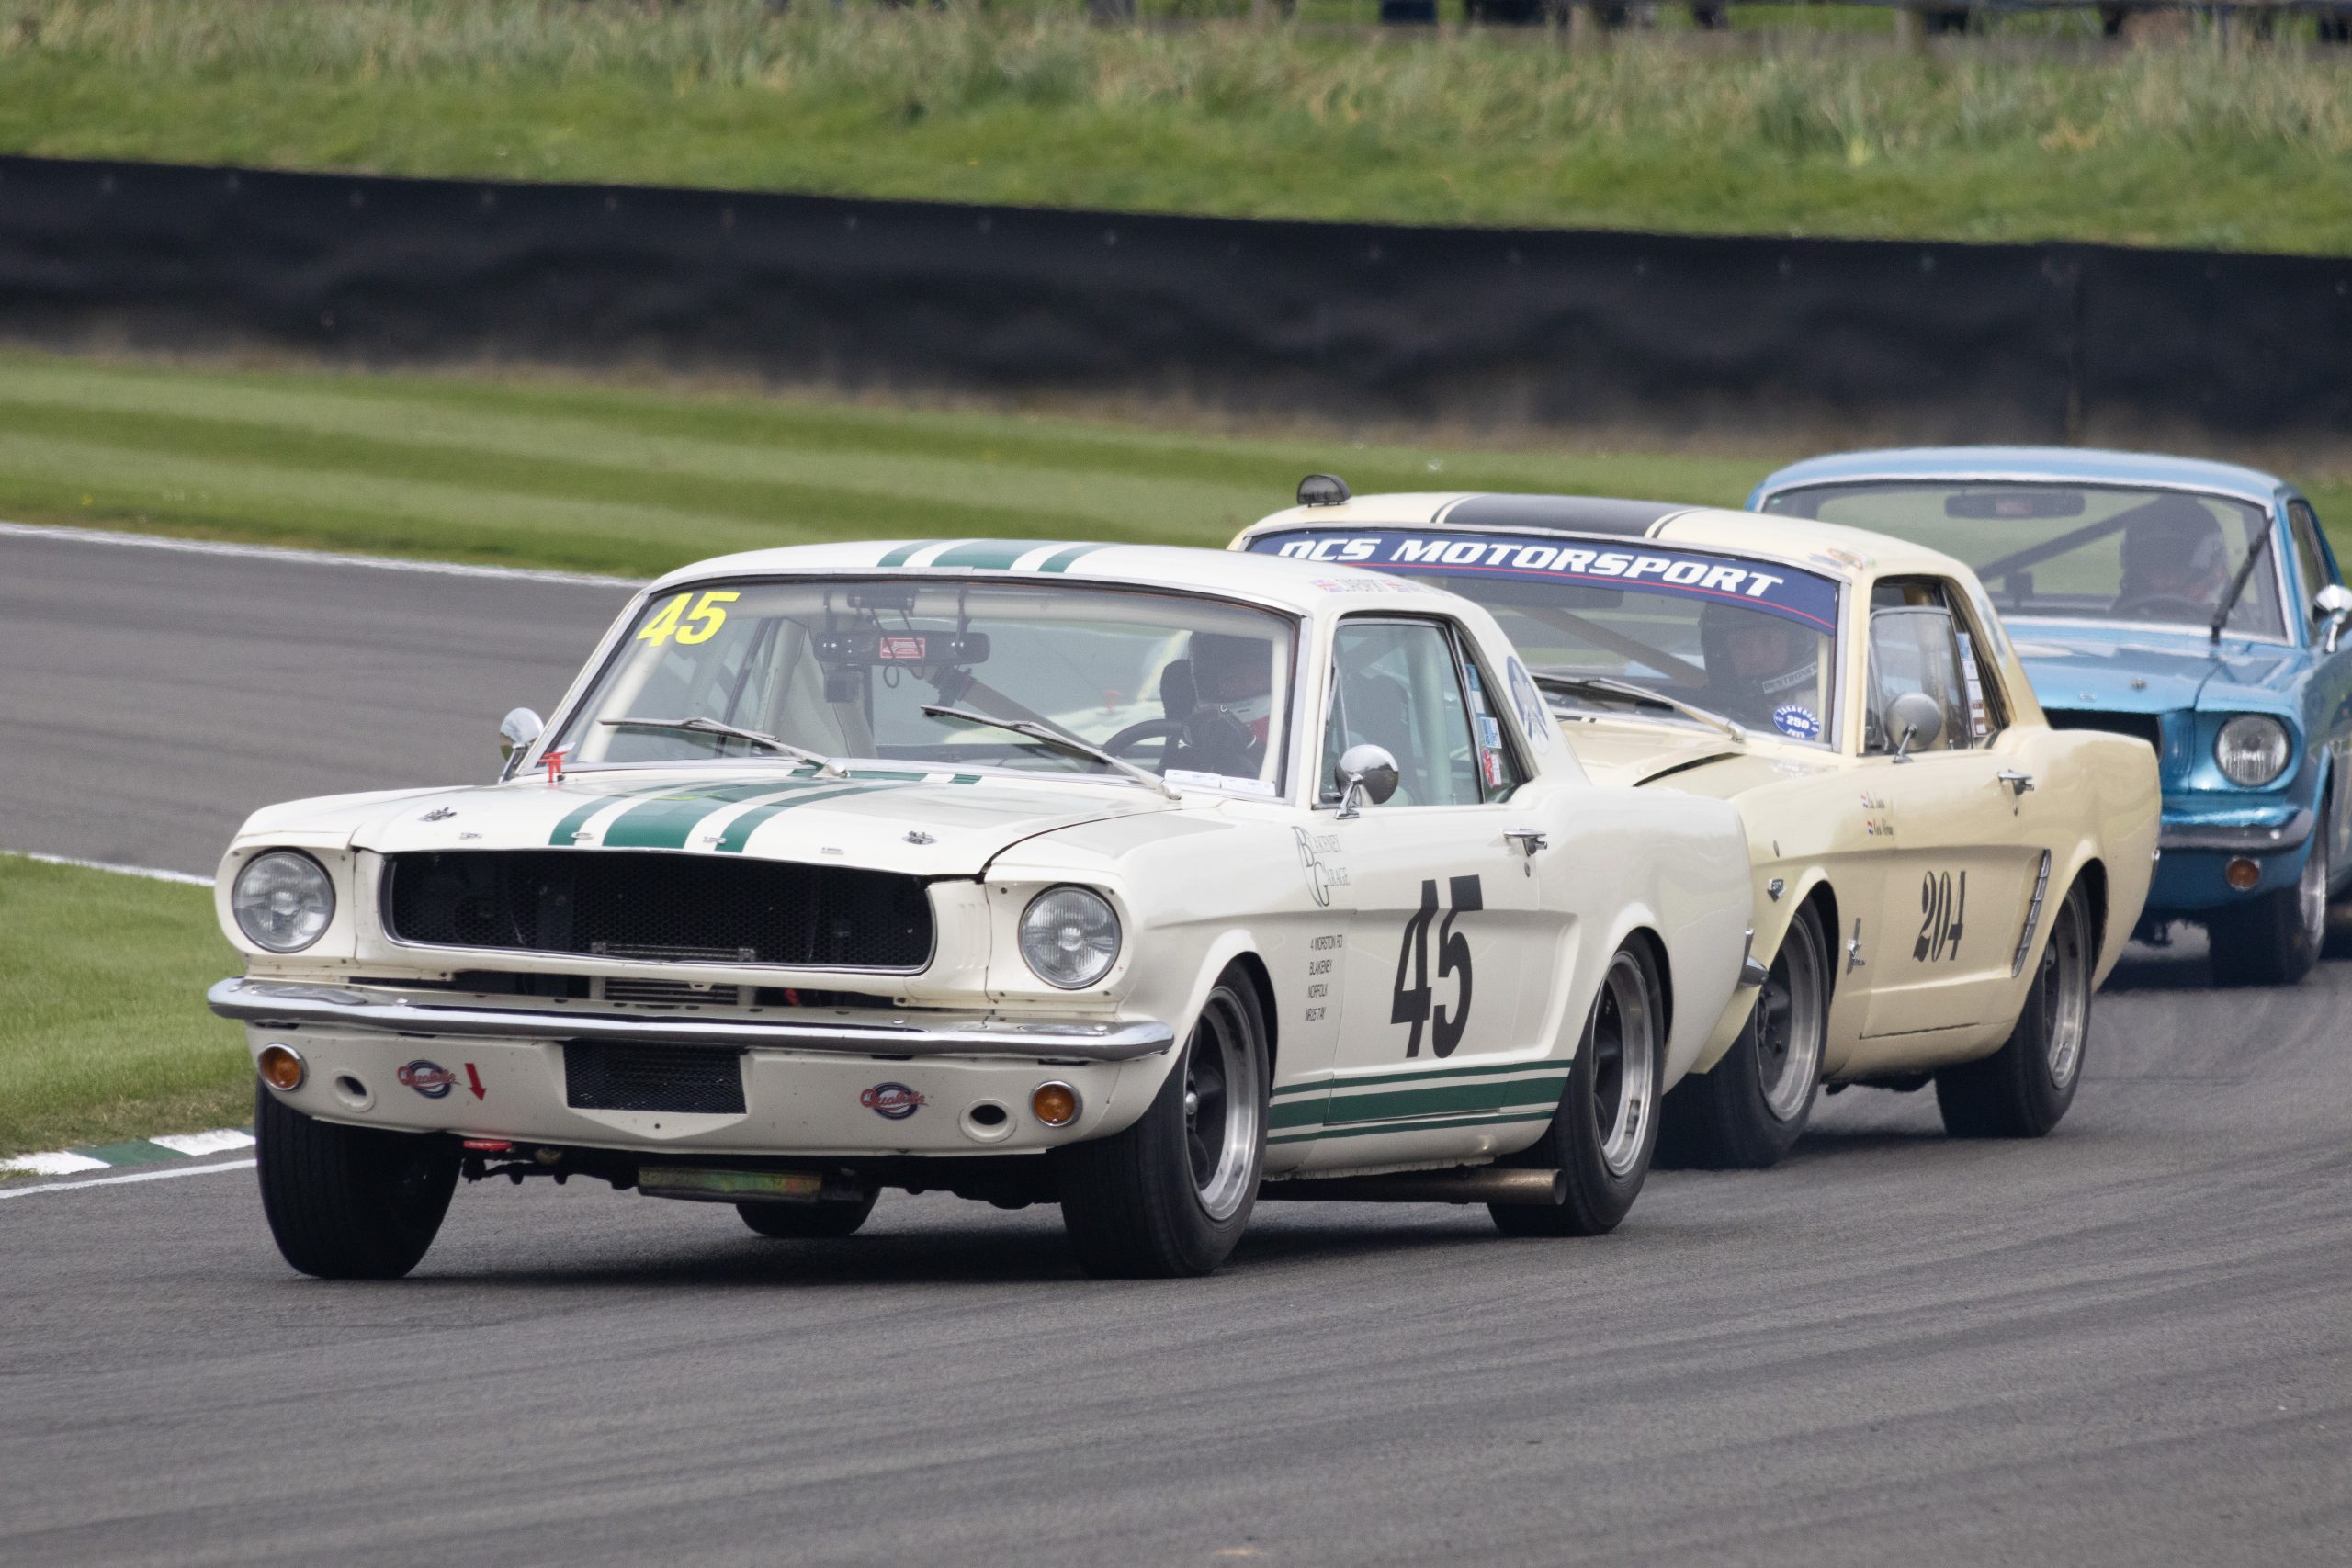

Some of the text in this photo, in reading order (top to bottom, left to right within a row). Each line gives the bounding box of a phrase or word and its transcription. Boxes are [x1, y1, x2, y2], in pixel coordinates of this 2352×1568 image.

[1388, 538, 1784, 598] MOTORSPORT
[636, 591, 741, 648] 45
[1912, 870, 1966, 963] 204
[1390, 874, 1484, 1059] 45
